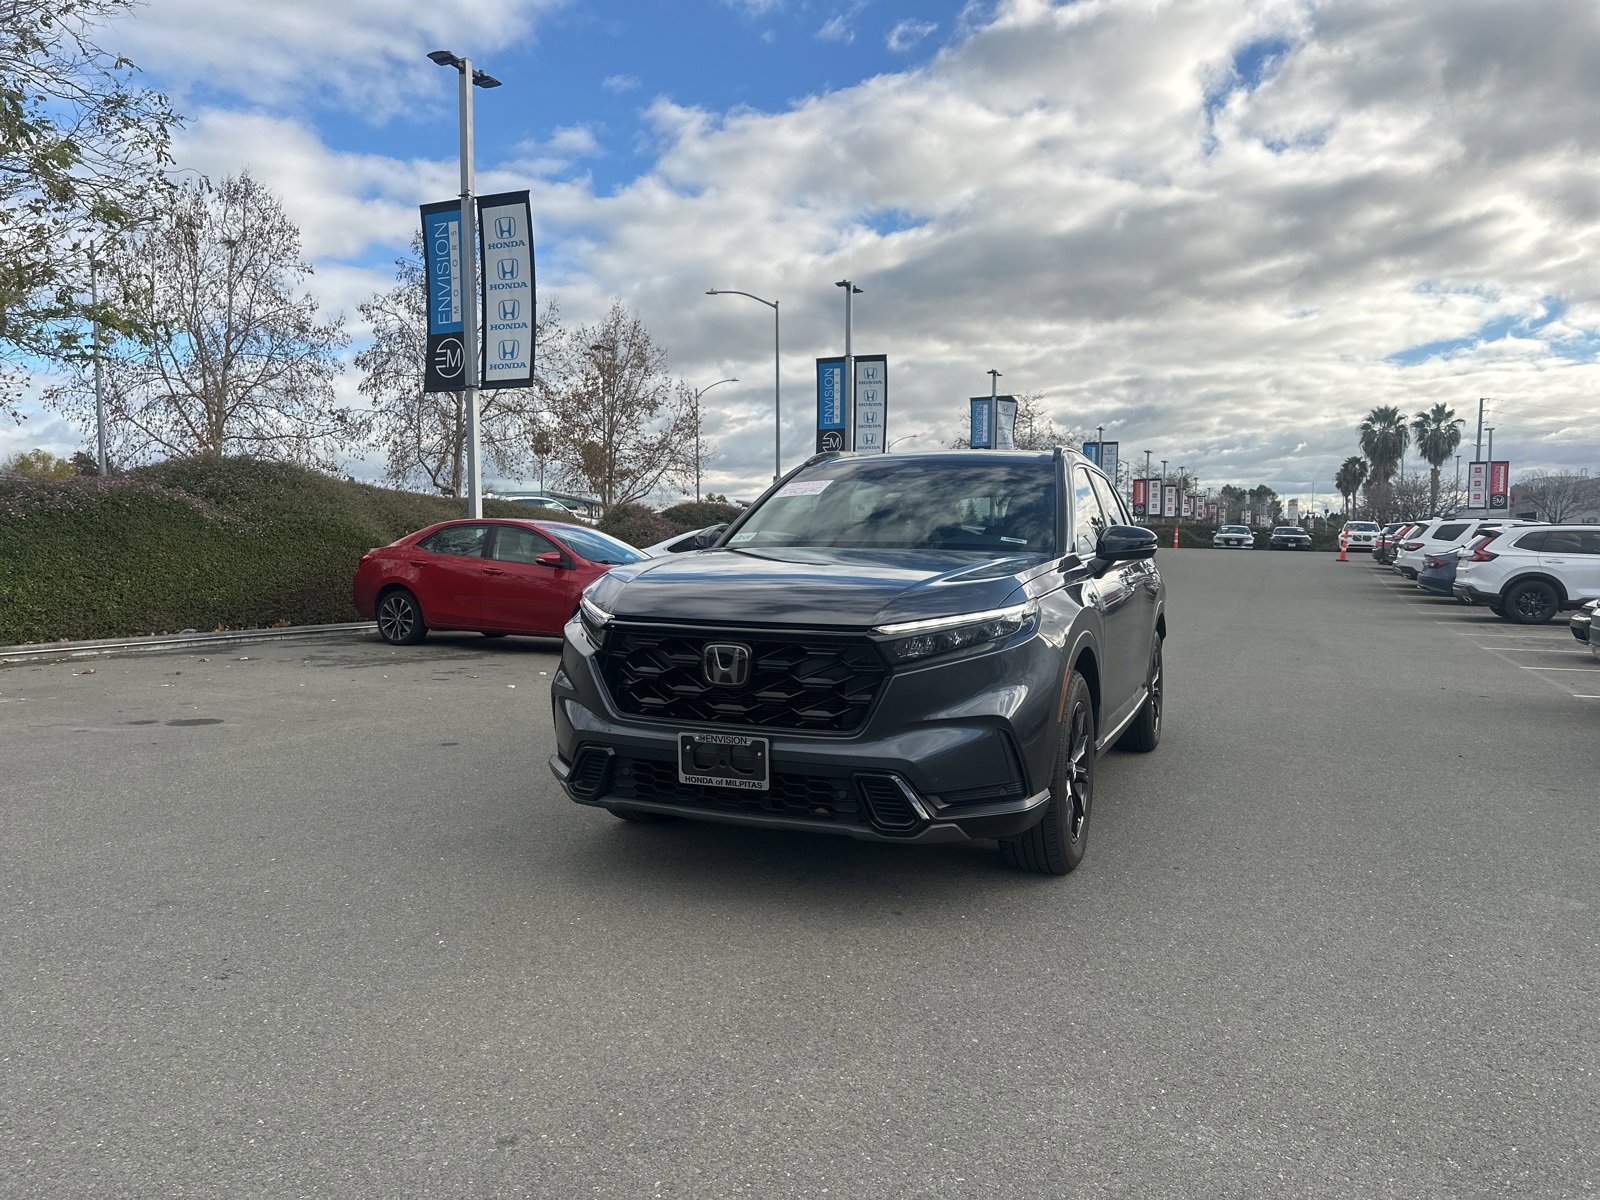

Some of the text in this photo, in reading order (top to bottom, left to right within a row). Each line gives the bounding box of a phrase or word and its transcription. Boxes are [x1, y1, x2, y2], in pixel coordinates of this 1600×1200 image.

[488, 239, 526, 250] HONDA
[434, 222, 451, 325] ENVISION
[451, 230, 460, 314] MOTORS
[489, 281, 529, 291] HONDA
[490, 321, 529, 331] HONDA
[489, 361, 527, 371] HONDA
[824, 368, 834, 425] ENVISION
[705, 734, 748, 745] ENVISION
[684, 775, 714, 785] HONDA
[725, 779, 763, 789] MILPITAS
